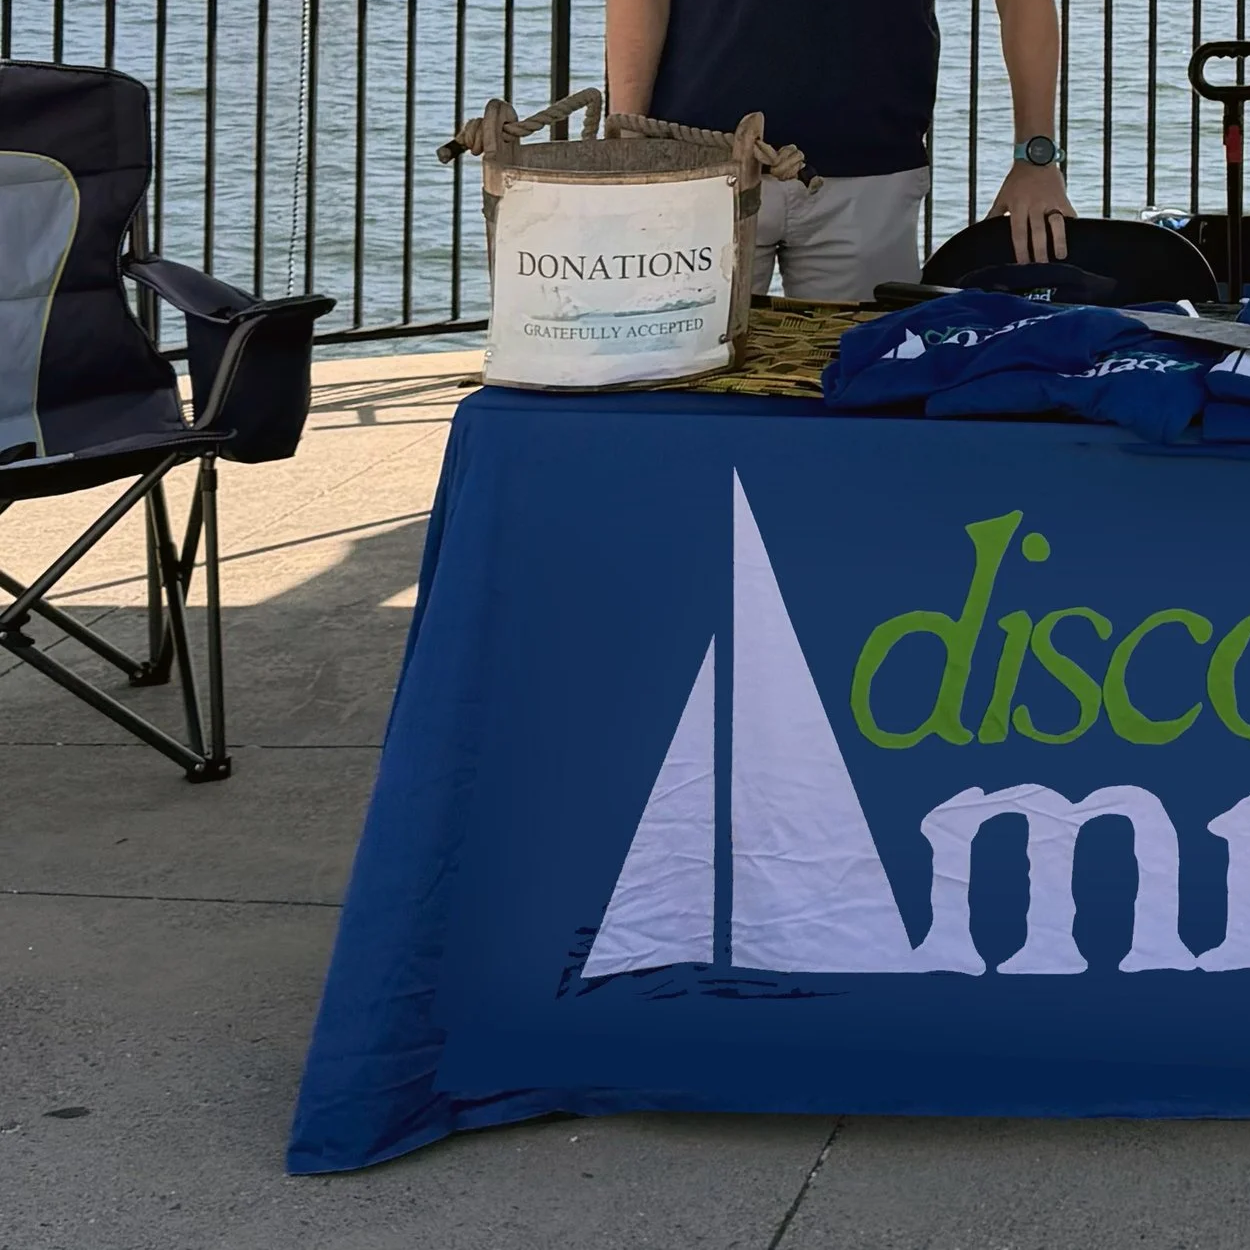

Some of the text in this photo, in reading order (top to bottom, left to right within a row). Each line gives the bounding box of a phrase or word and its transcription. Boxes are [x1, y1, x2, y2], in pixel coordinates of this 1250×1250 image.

[517, 247, 712, 280] DONATIONS
[524, 317, 704, 340] GRATEFULLY ACCEPTED
